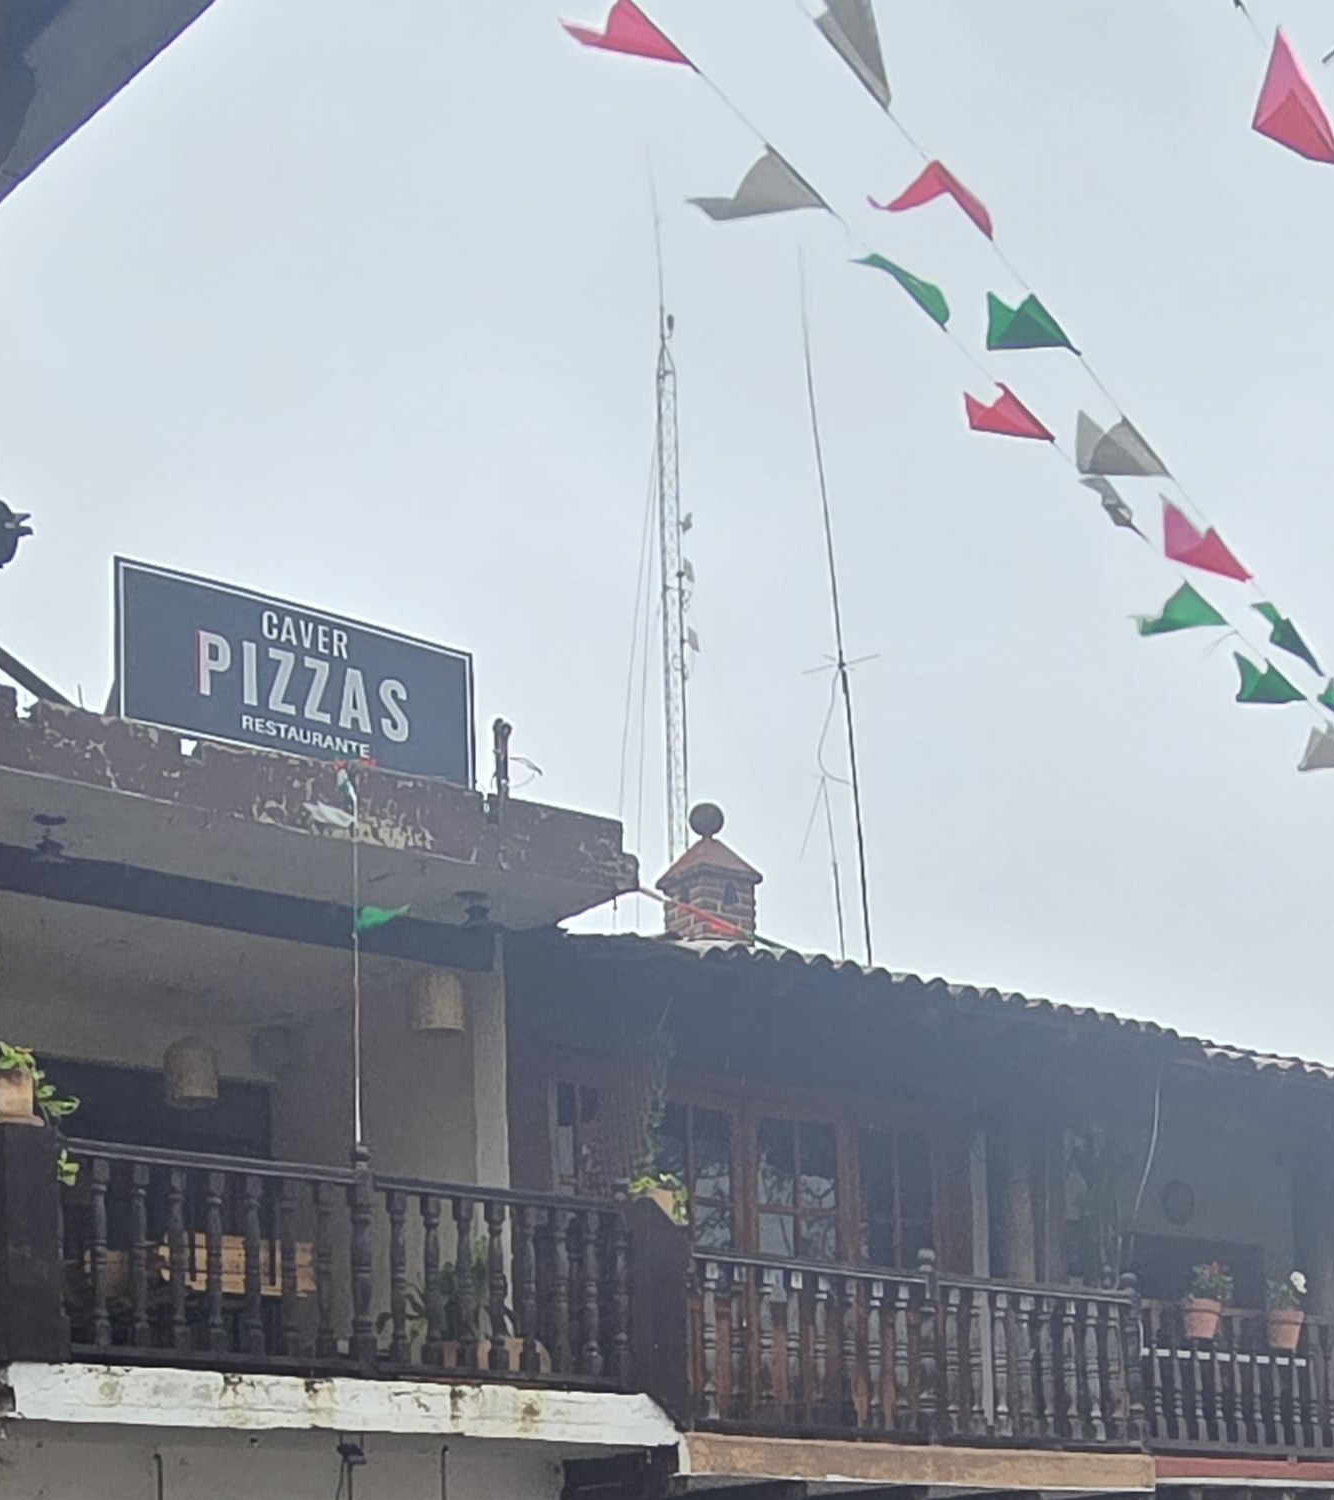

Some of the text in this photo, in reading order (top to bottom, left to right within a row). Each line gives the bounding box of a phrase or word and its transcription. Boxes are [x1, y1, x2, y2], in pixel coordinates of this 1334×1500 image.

[261, 610, 348, 660] CAVER
[197, 630, 409, 743] PIZZAS
[241, 714, 371, 759] RESTAURANTE
